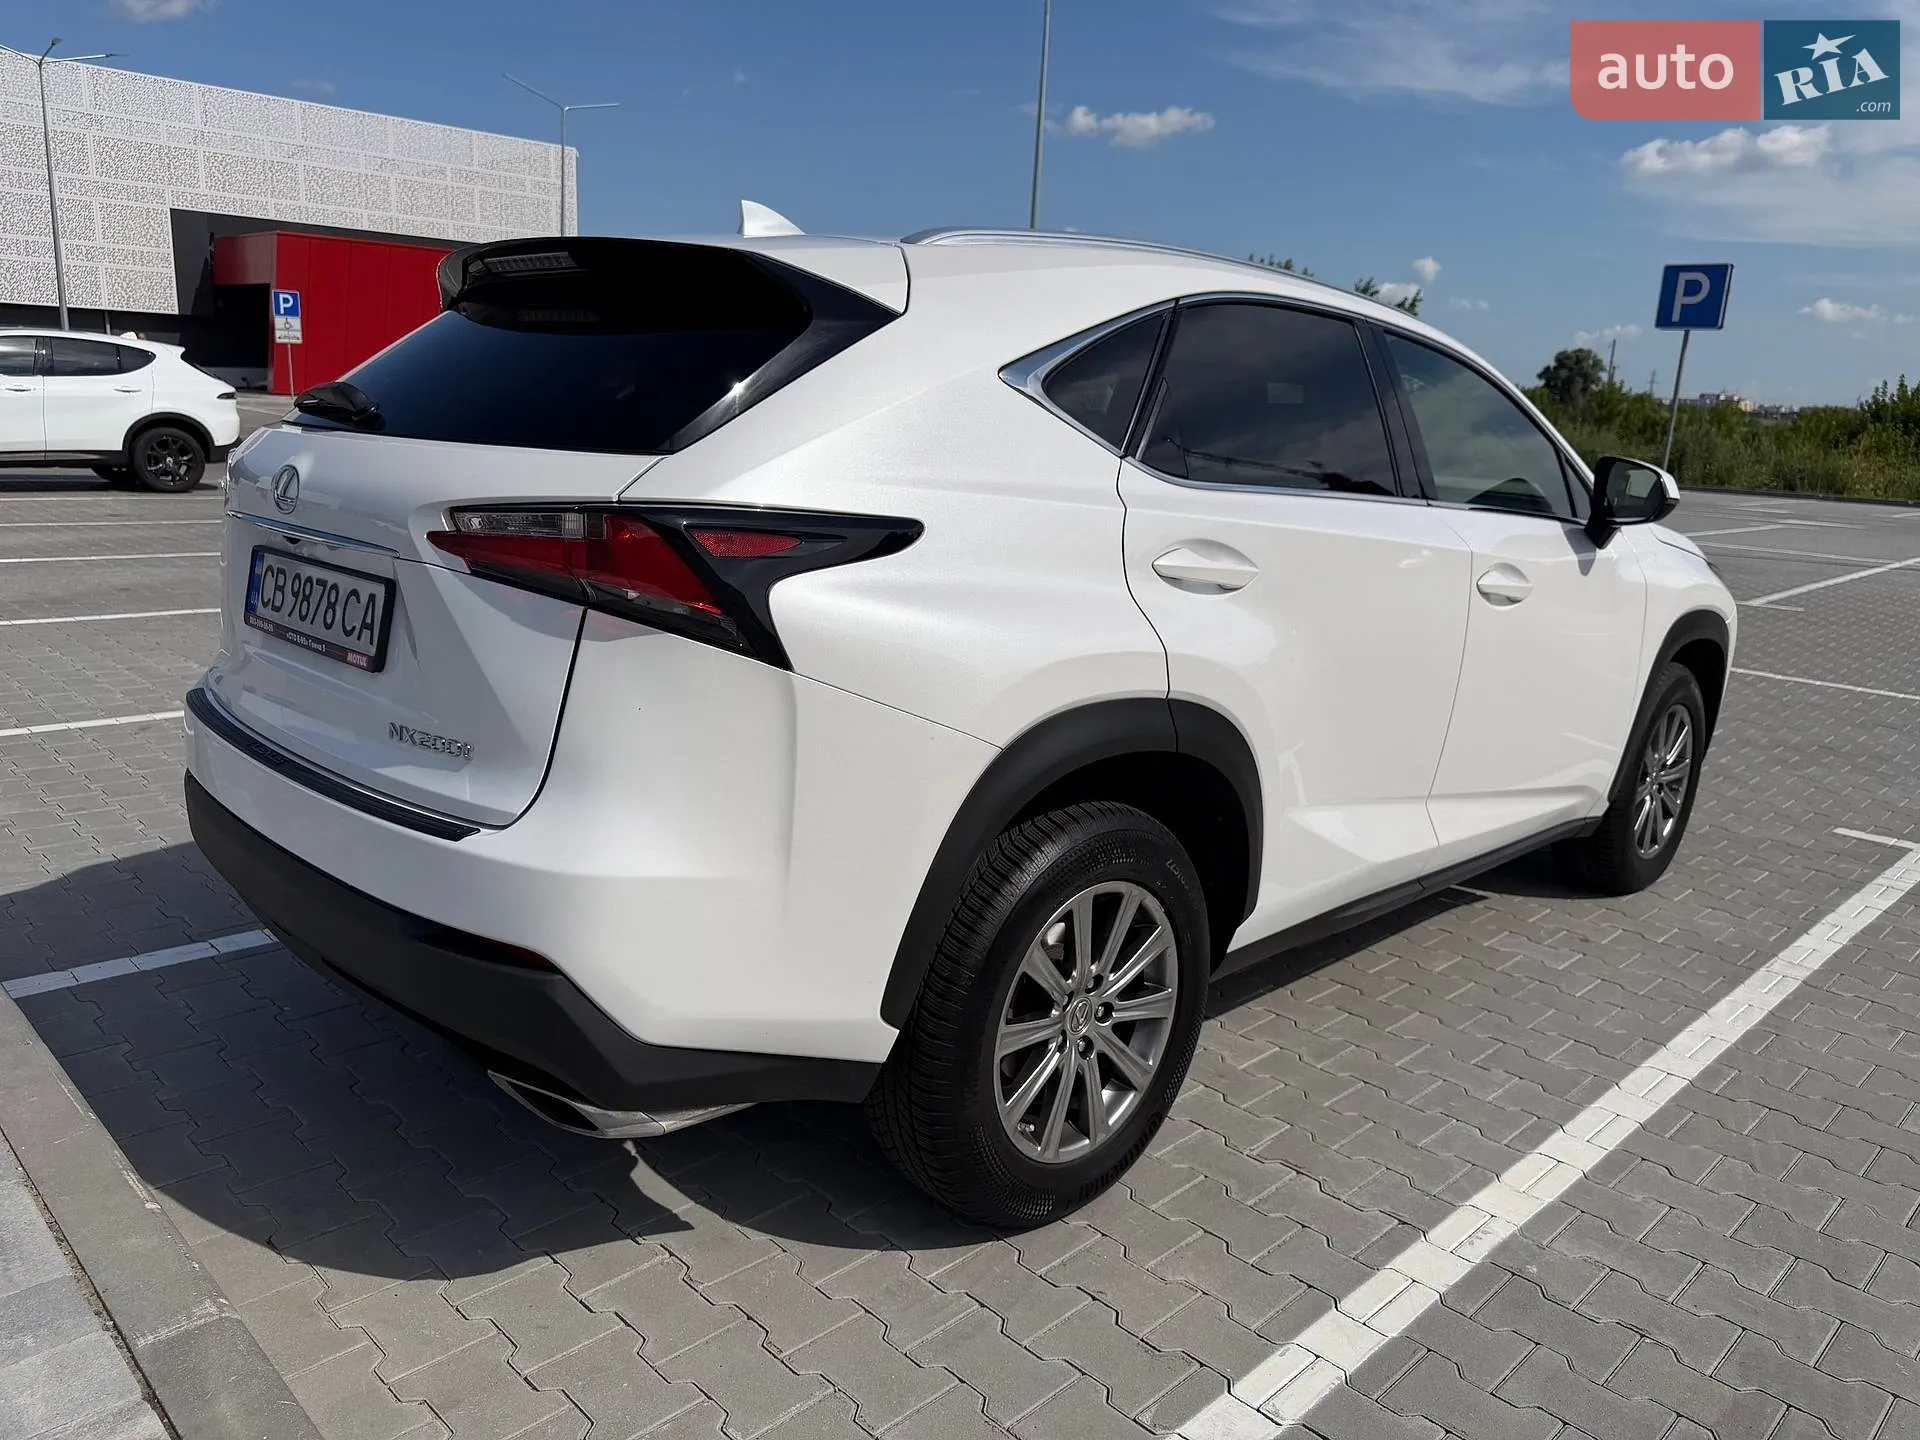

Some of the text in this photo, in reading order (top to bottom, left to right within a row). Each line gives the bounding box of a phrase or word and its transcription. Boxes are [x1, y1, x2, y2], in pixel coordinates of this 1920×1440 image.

[279, 292, 294, 315] P
[1671, 271, 1711, 322] P
[260, 564, 377, 646] CB 9878 CA
